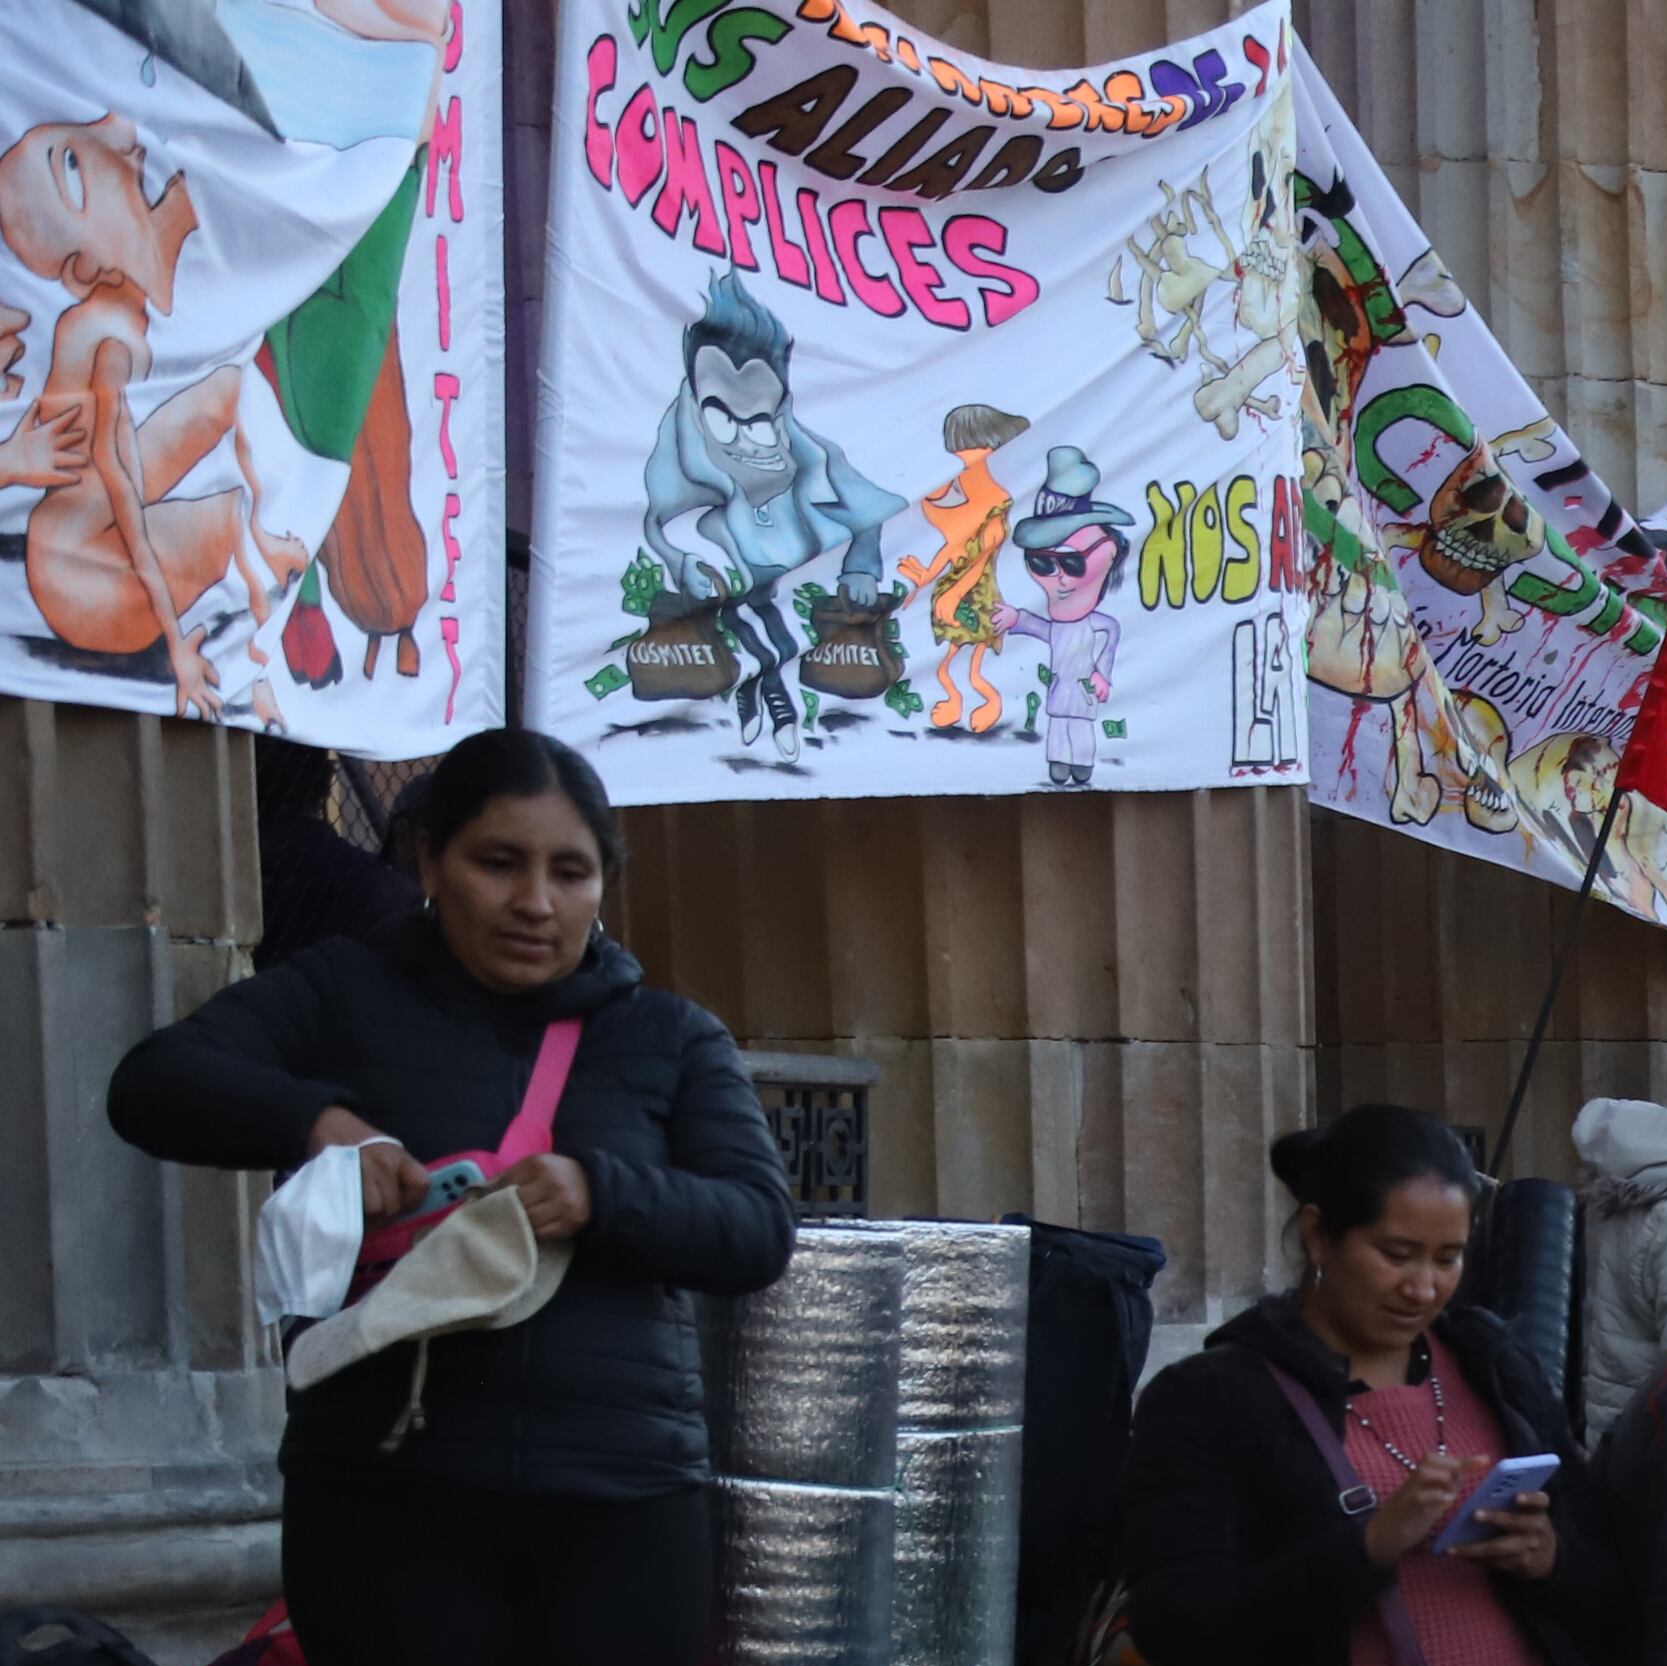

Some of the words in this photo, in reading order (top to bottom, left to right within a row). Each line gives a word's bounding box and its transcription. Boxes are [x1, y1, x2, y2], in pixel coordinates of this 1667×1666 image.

[584, 33, 1041, 331] COMPLICES
[1138, 474, 1262, 612] NOS
[629, 640, 717, 668] COSMITET
[1231, 612, 1299, 767] LA
